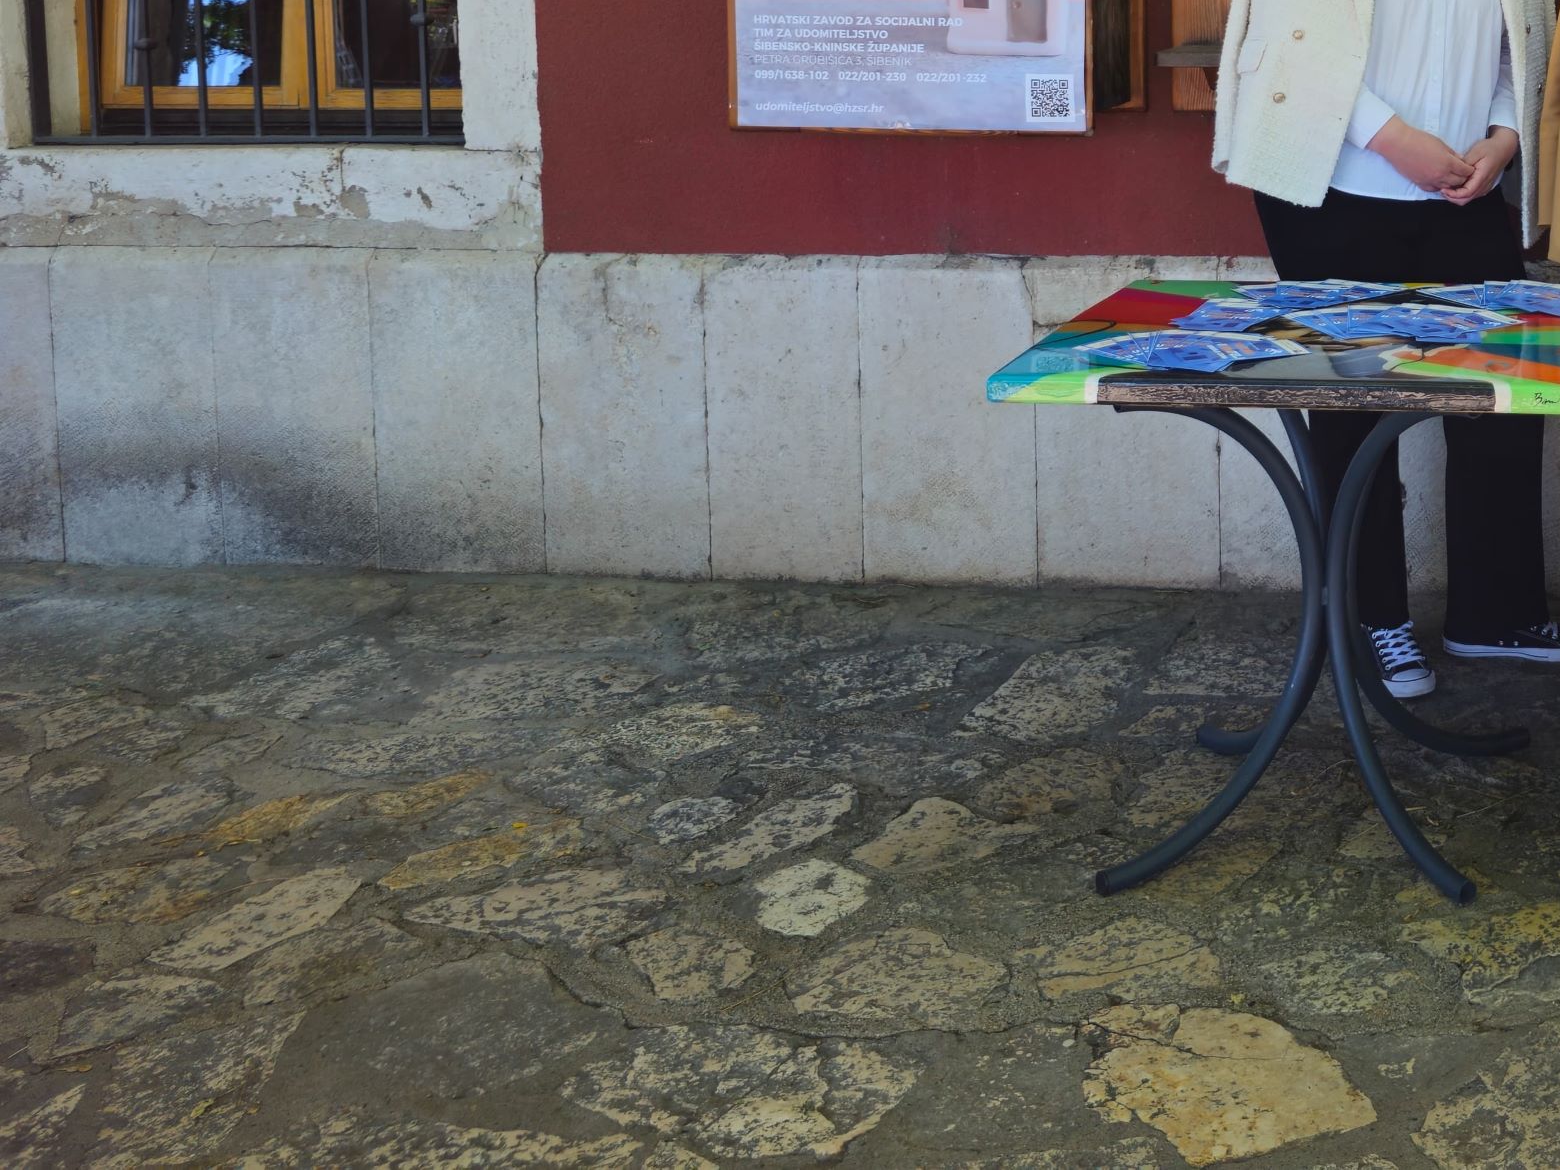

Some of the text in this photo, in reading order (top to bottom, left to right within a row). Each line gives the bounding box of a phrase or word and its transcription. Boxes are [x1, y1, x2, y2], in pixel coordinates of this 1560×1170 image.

[753, 15, 963, 27] HRVATSKI ZAVOD ZA SOCIJALNI RAD
[754, 28, 888, 39] TIM ZA UDOMITELJSTVO
[754, 41, 924, 53] ŠIBENSKO-KNINSKE ŽUPANIJE
[754, 54, 791, 65] PETRA
[754, 69, 987, 83] 099/1638-102 022/201-230 022/201-232
[755, 101, 884, 115] udomiteljstvo@hzsr.hr
